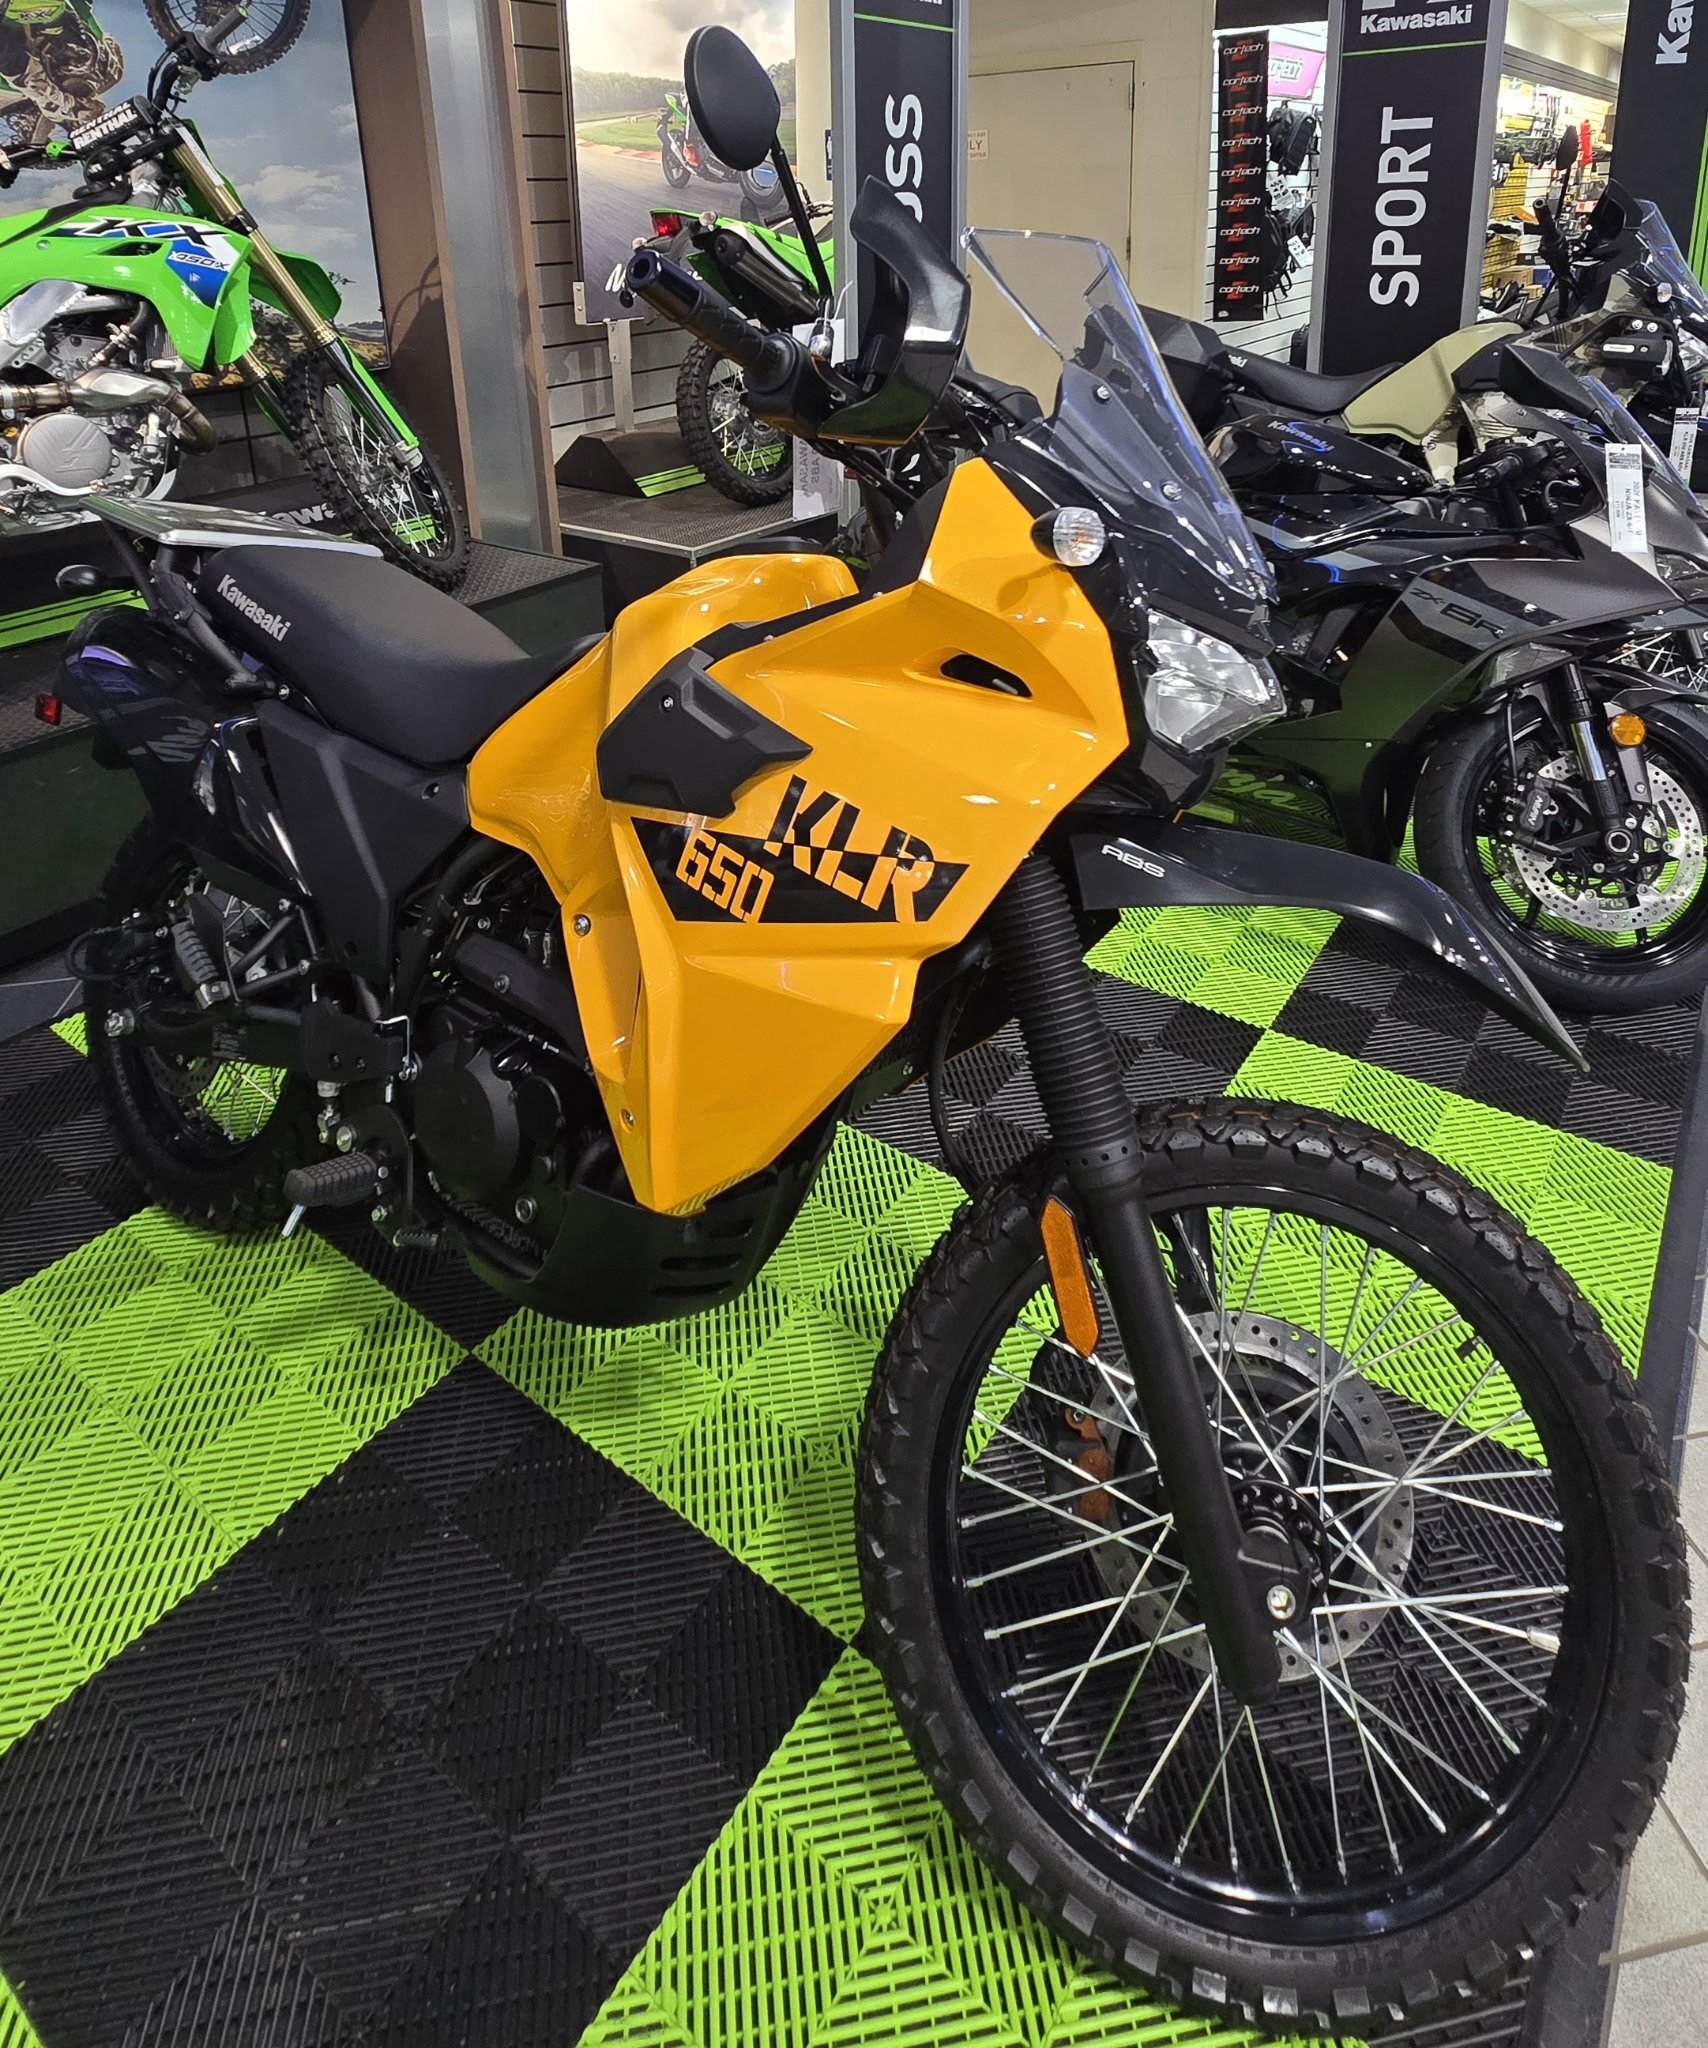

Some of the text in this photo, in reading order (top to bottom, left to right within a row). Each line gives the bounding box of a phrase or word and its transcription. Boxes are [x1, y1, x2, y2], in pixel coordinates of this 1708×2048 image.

[1360, 4, 1473, 34] Kawasaki
[1223, 43, 1264, 55] cortech
[1222, 74, 1263, 86] cortech
[1221, 106, 1262, 117] cortech
[72, 108, 138, 150] RENTHAL
[967, 140, 983, 150] LY
[1221, 136, 1262, 148] cortech
[1221, 167, 1261, 178] cortech
[1220, 197, 1260, 208] cortech
[1369, 106, 1433, 307] SPORT
[75, 217, 230, 248] KX
[1220, 226, 1260, 237] cortech
[1219, 256, 1259, 267] cortech
[1218, 285, 1259, 295] cortech
[1267, 420, 1335, 450] Kawasaki
[216, 574, 292, 642] Kawasaki
[762, 773, 936, 923] KLR
[1101, 844, 1166, 878] ABS
[676, 827, 775, 922] 650
